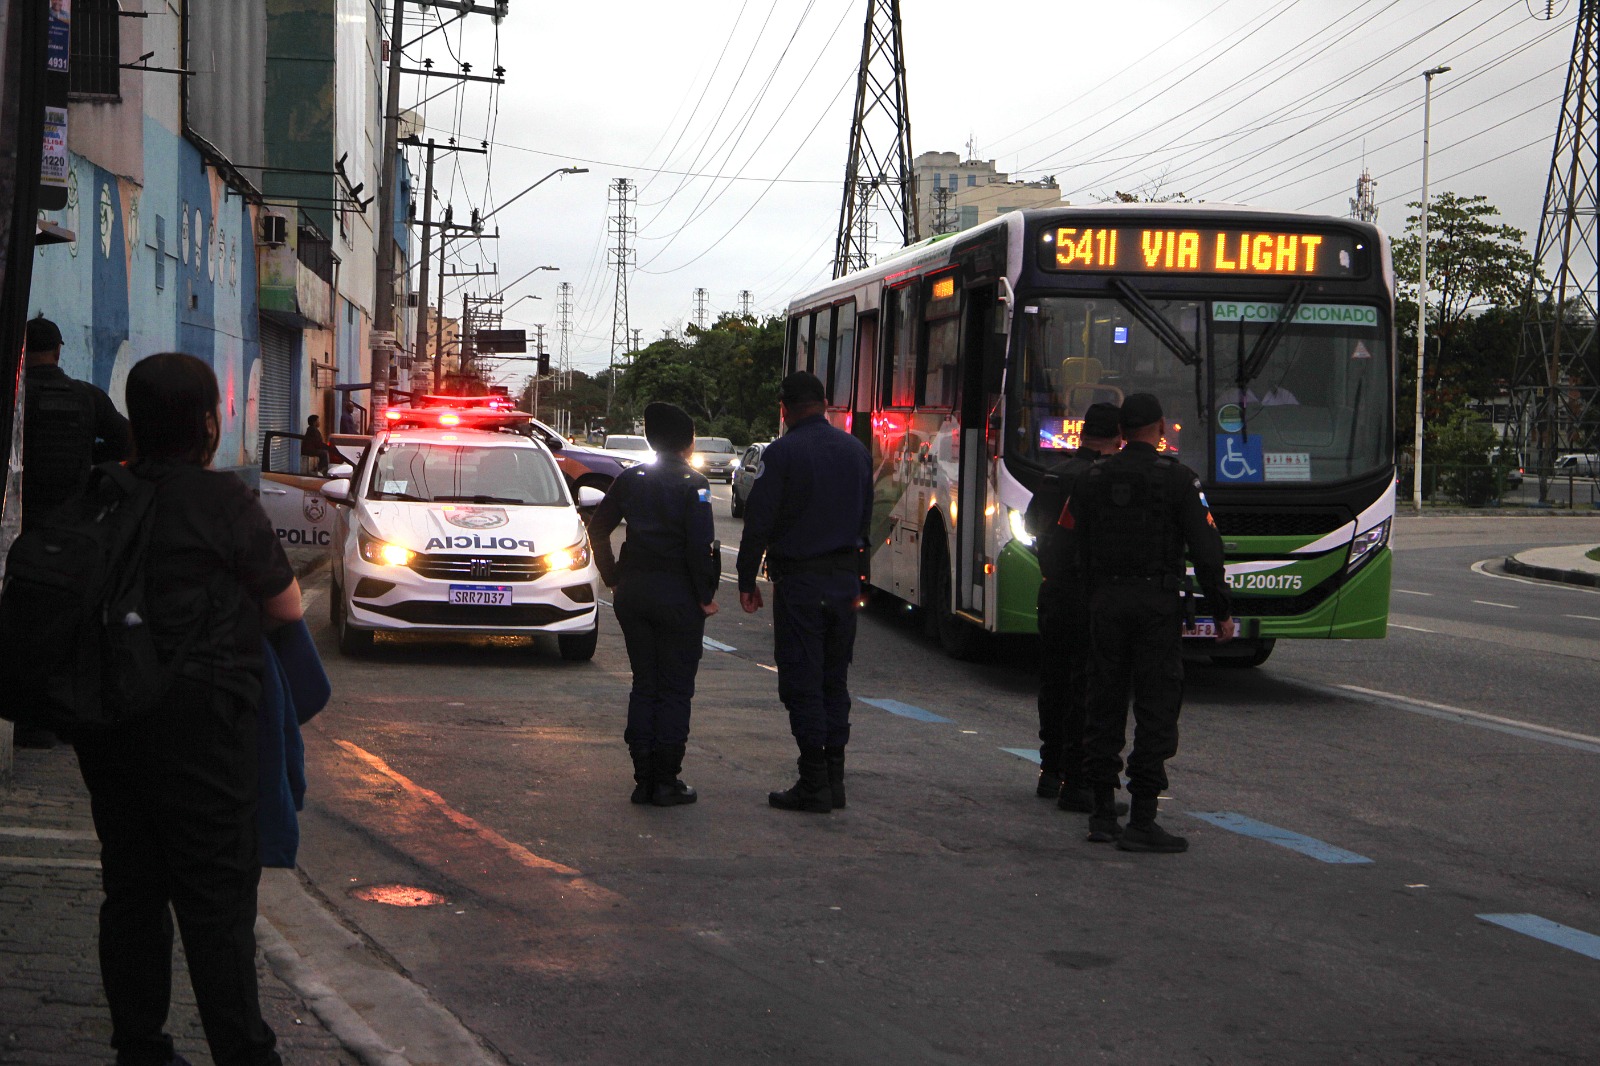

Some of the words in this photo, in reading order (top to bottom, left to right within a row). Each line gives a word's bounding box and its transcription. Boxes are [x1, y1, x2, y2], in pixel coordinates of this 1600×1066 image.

[48, 57, 67, 69] 4931
[1142, 230, 1200, 269] VIA
[1215, 233, 1323, 272] LIGHT
[1214, 304, 1238, 318] AR
[1243, 305, 1377, 323] CONICIONADO
[470, 559, 493, 577] FIAT
[1224, 574, 1245, 589] RJ
[1246, 574, 1303, 590] 200.175
[454, 590, 505, 605] SRR7D37
